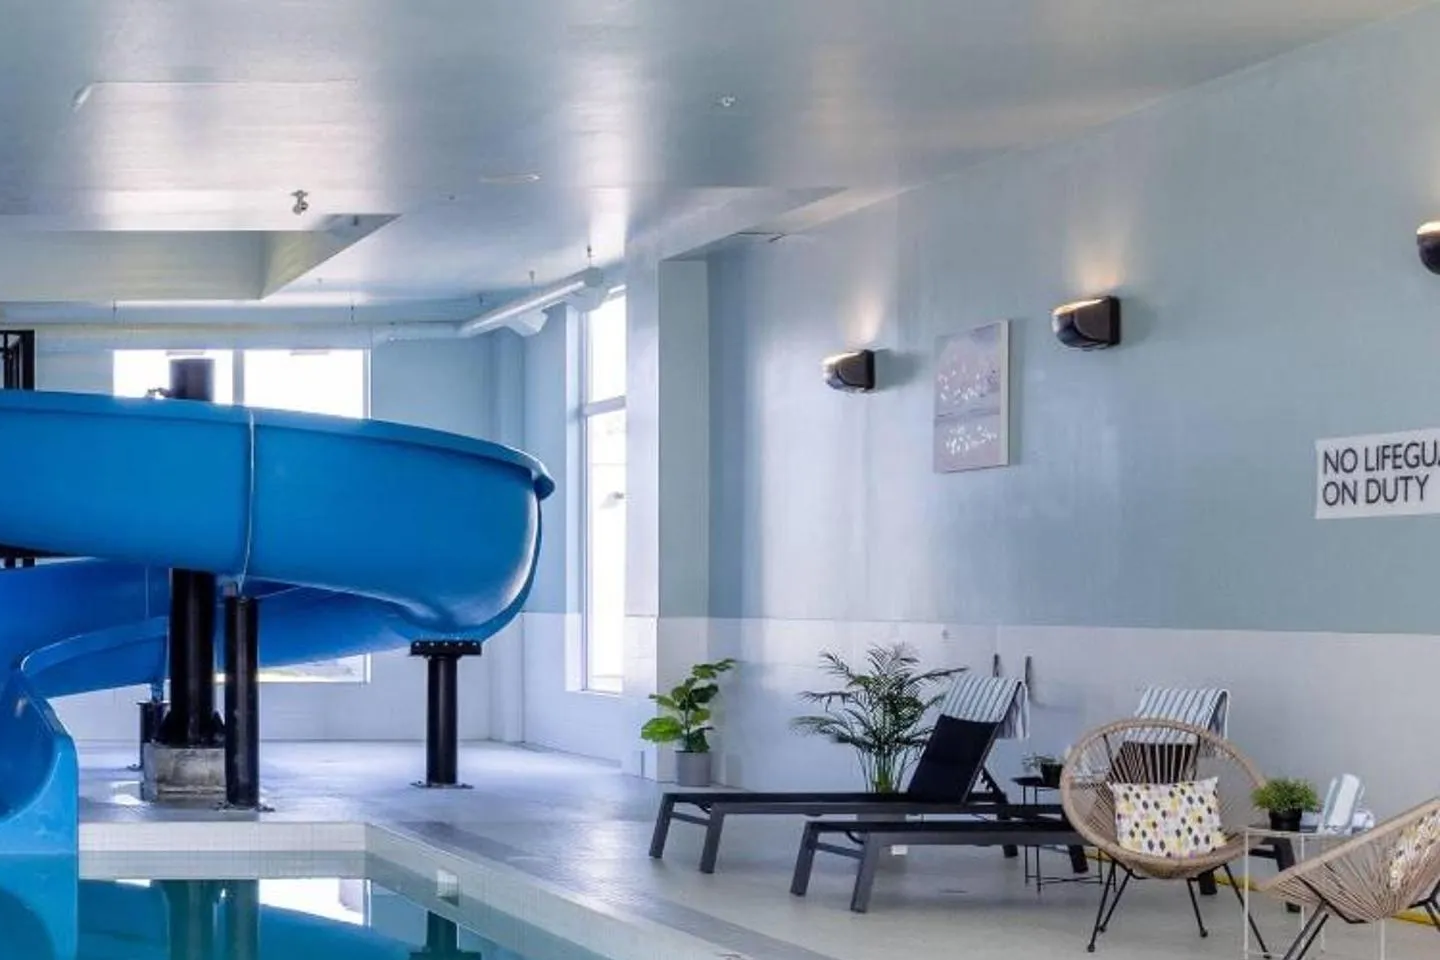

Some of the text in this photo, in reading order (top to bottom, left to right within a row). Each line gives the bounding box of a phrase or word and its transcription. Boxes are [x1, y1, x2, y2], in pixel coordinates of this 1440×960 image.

[1323, 440, 1440, 474] NO LIFEGU
[1322, 474, 1429, 506] ON DUTY
